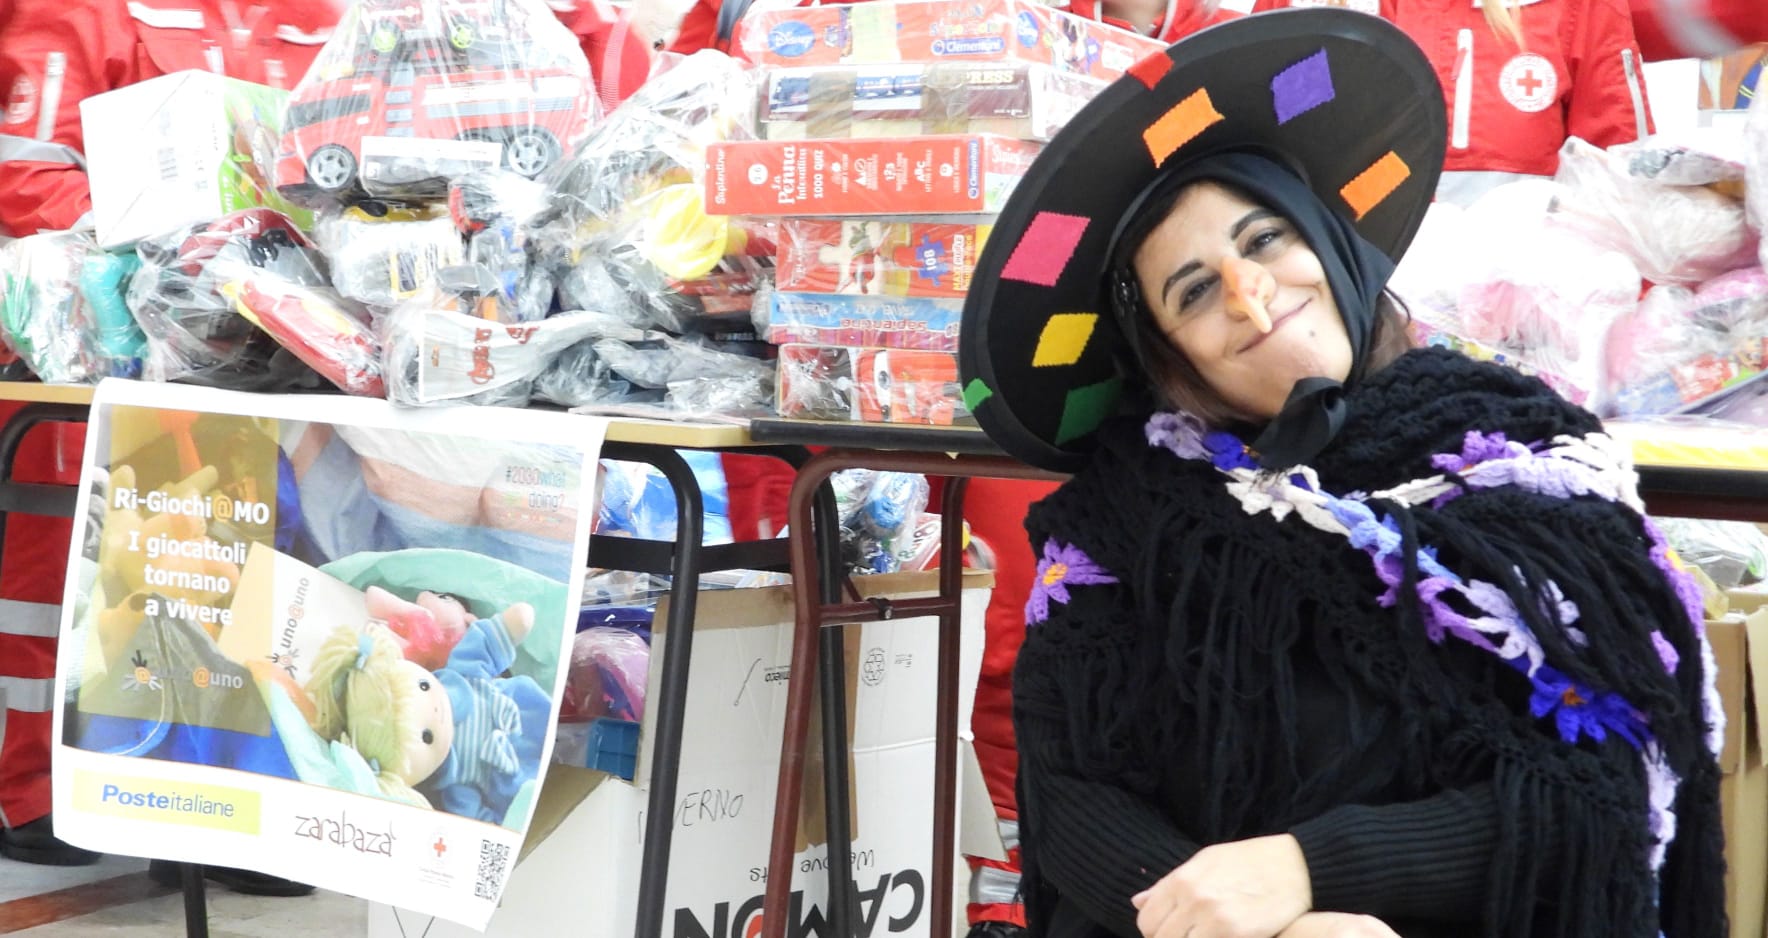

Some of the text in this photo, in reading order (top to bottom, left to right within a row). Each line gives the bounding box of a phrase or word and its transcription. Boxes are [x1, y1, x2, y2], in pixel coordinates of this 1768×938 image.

[946, 39, 1001, 53] Clementoni
[778, 146, 795, 205] Penna
[813, 149, 824, 199] 1000 QUIZ
[914, 161, 926, 182] ABC
[970, 142, 978, 187] Clementoni
[924, 249, 937, 271] 108
[114, 487, 270, 525] Ri-Giochi@MO
[128, 530, 247, 565] I giocattoli
[144, 563, 231, 593] tornano
[144, 598, 233, 625] a vivere
[280, 577, 310, 649] uno@uno
[748, 866, 768, 882] ts
[799, 856, 829, 873] ove
